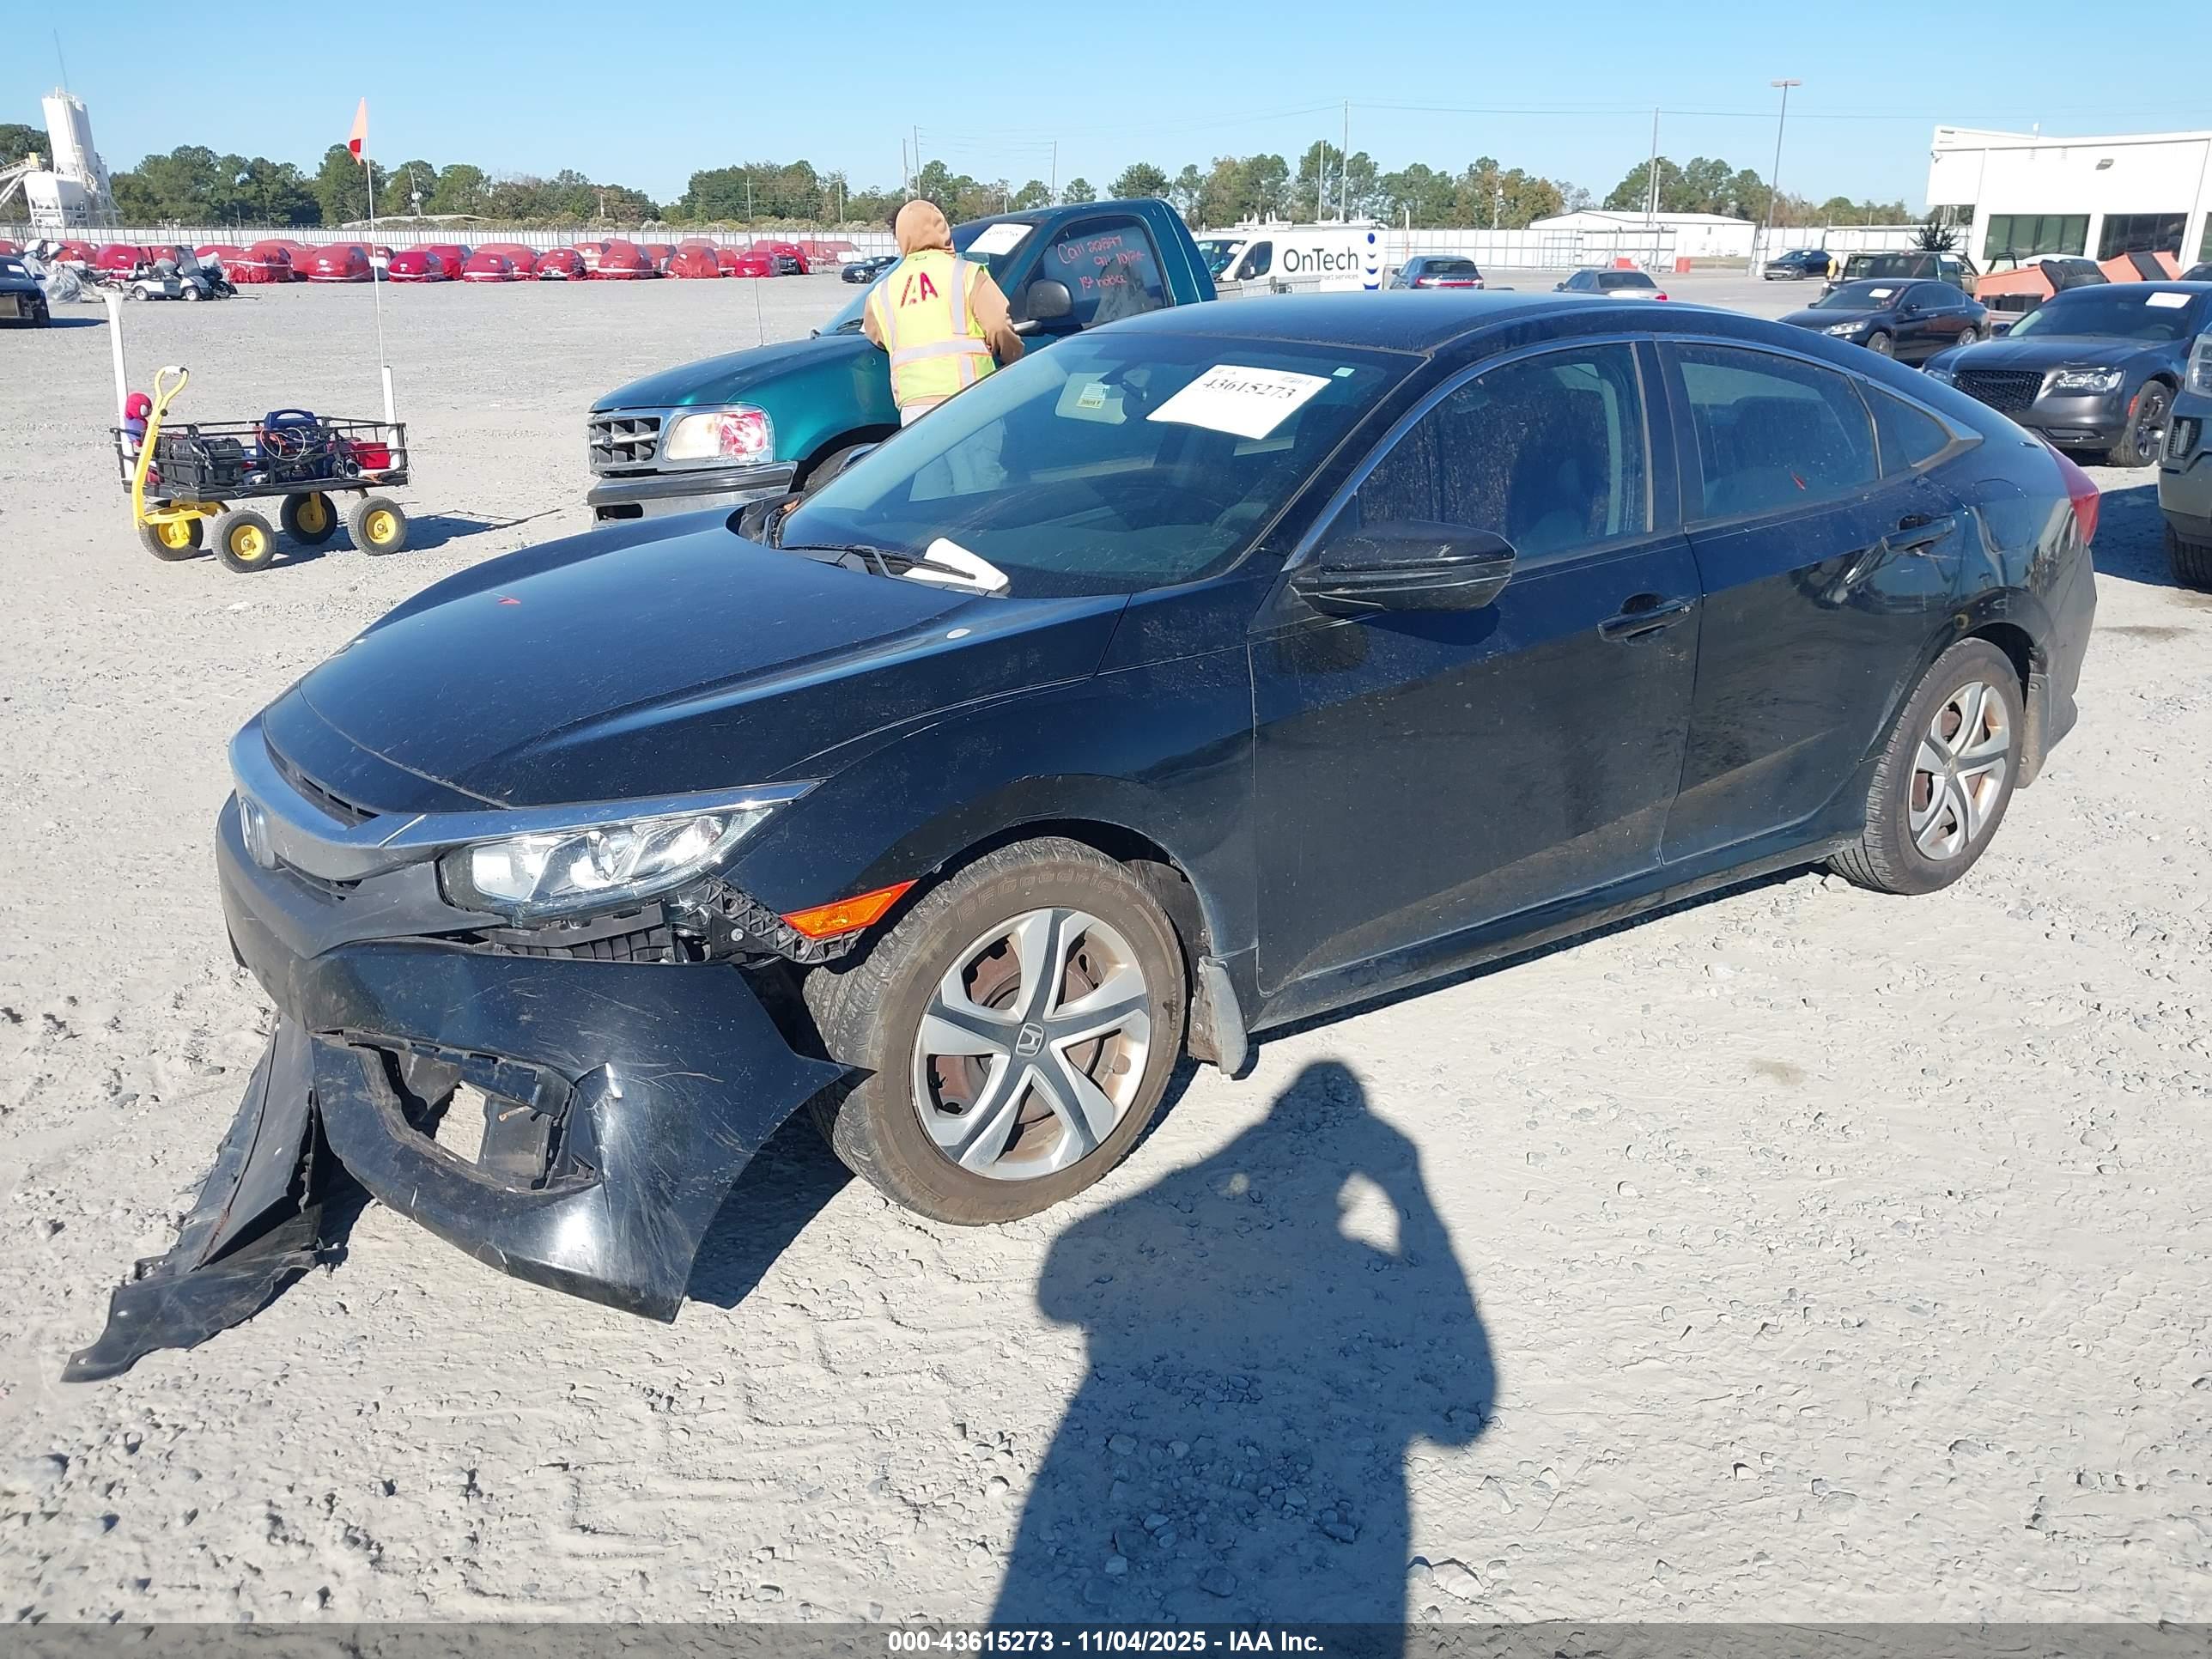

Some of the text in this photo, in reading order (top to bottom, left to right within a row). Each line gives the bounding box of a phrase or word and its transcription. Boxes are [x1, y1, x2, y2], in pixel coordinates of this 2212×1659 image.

[1057, 243, 1085, 264] Call
[1283, 246, 1358, 273] OnTech
[1203, 378, 1297, 399] 43615273
[957, 871, 1129, 922] BFGoodrich
